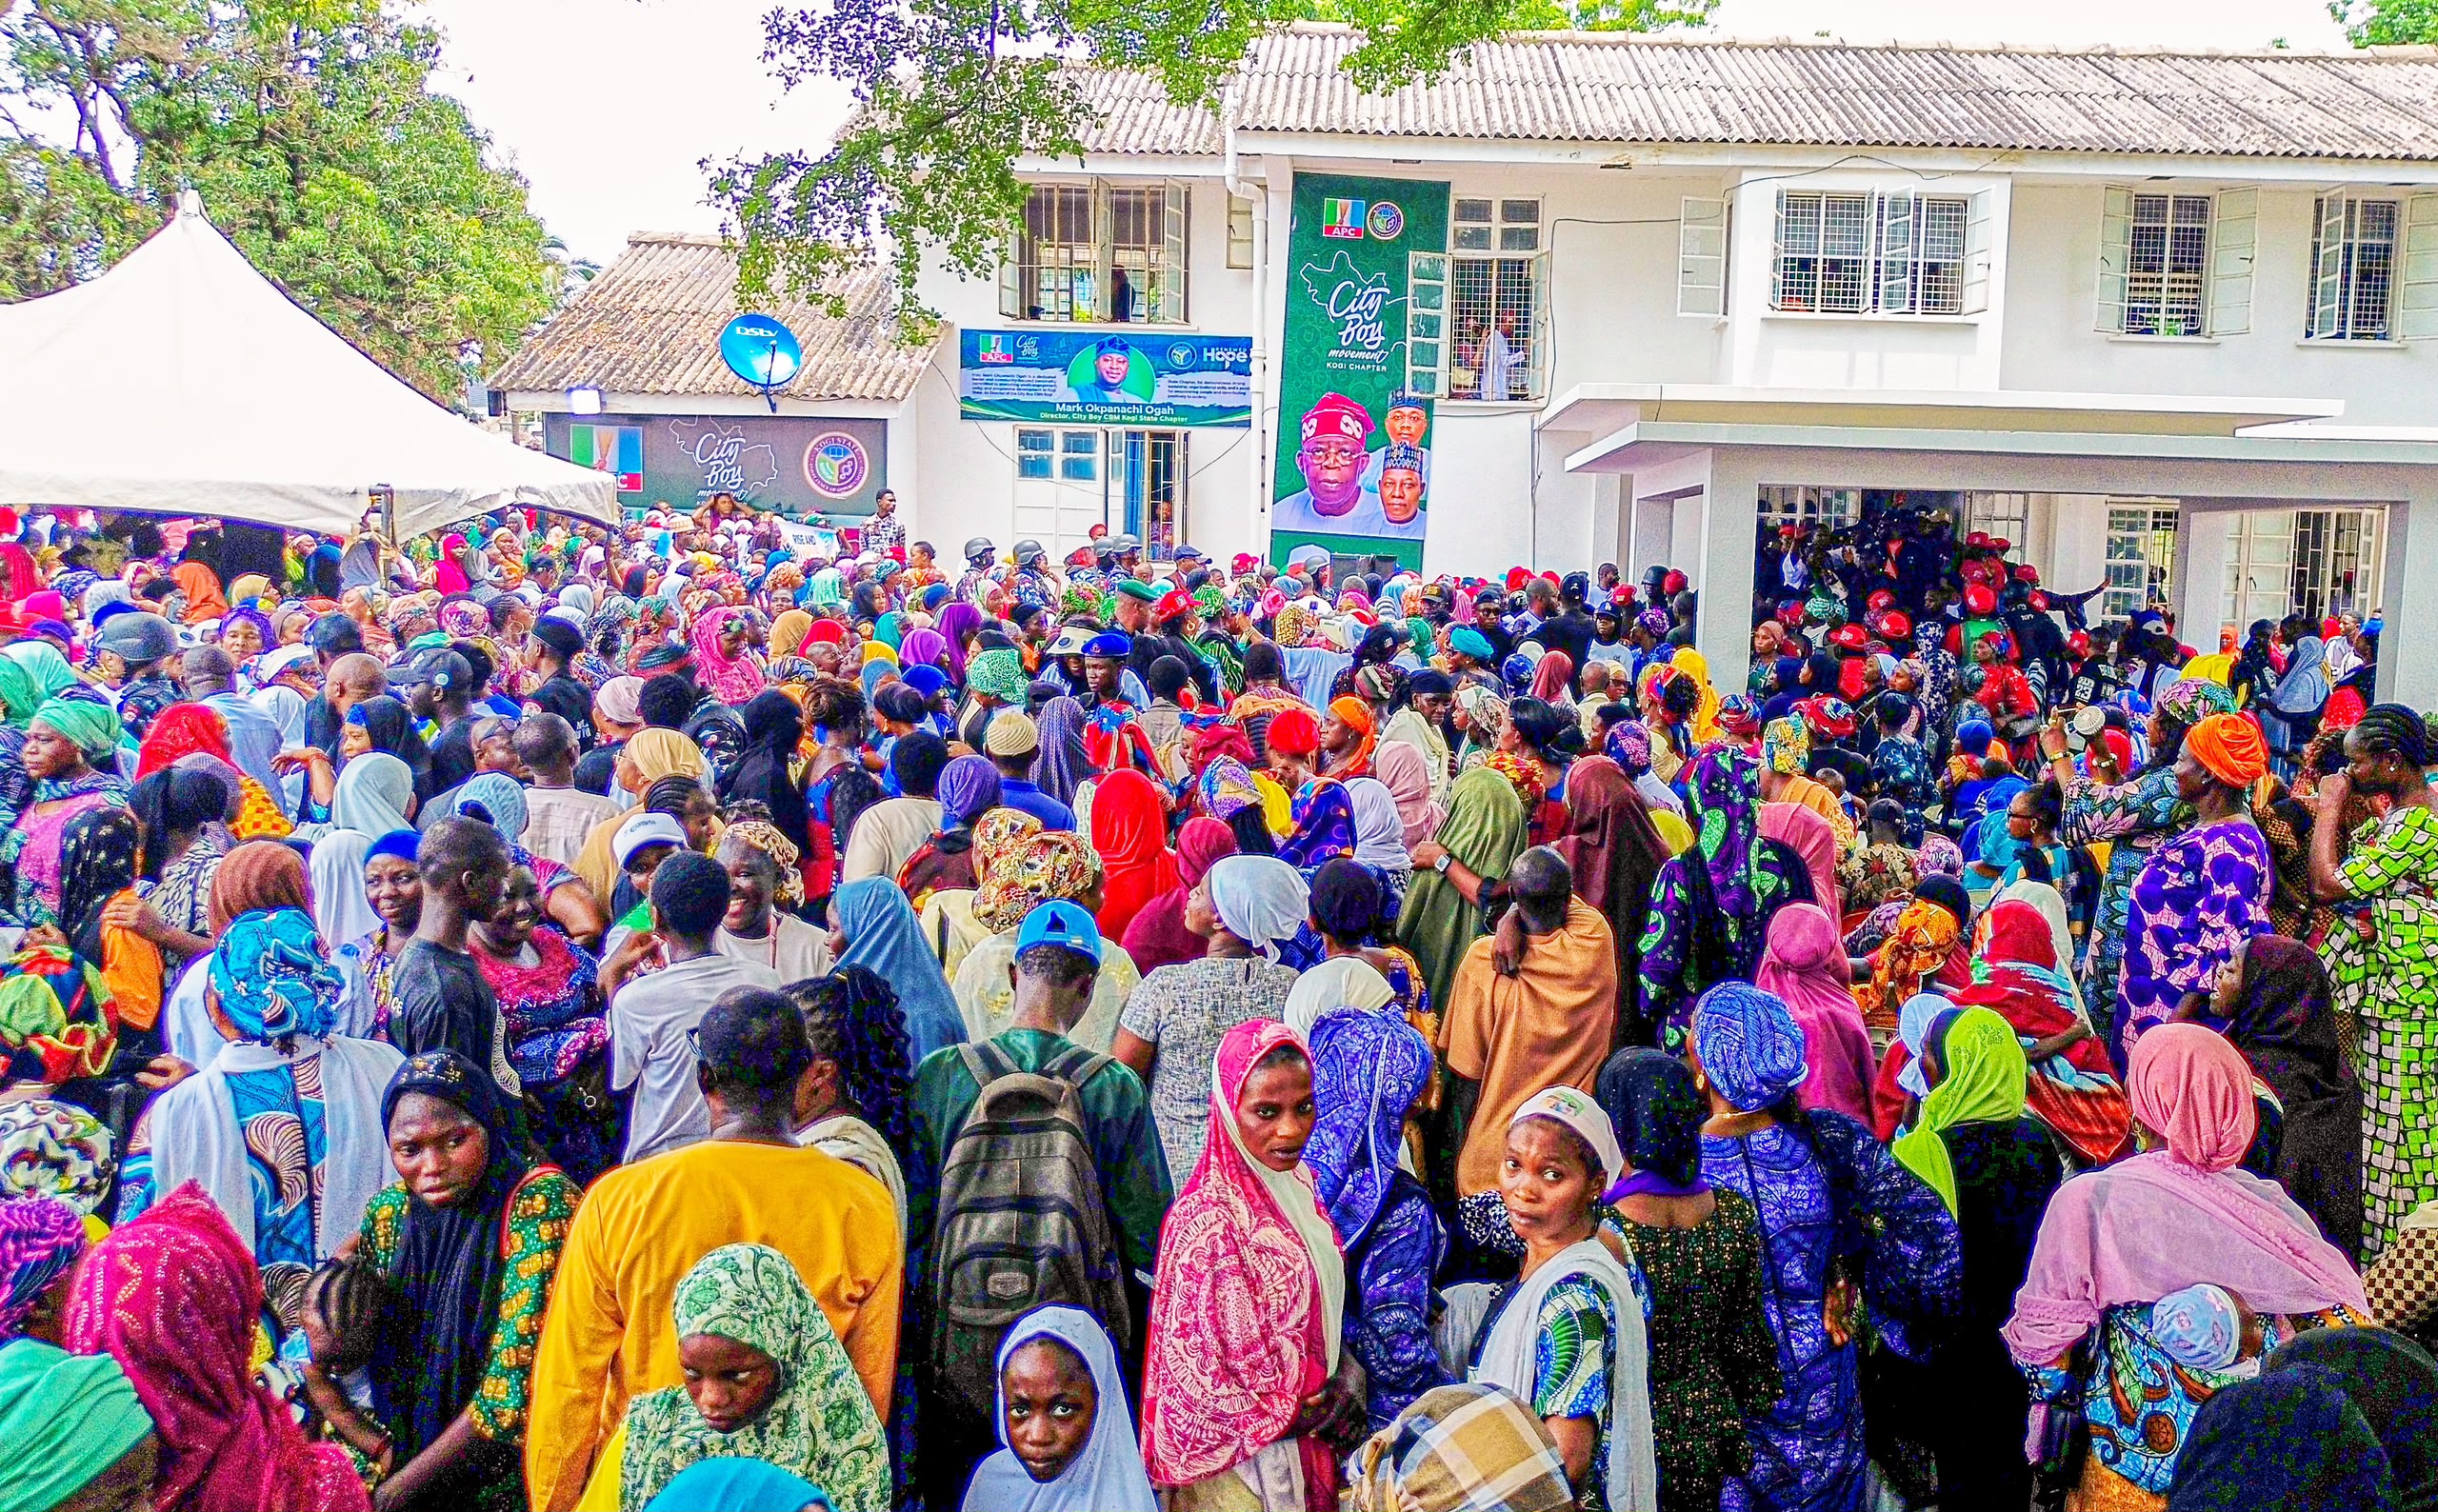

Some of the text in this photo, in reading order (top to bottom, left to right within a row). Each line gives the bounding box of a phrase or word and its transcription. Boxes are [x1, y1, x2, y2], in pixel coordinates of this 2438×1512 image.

[1332, 227, 1356, 236] APC
[1329, 280, 1390, 320] City
[1338, 313, 1385, 350] Boy
[1016, 335, 1040, 348] City
[988, 353, 1007, 362] APC
[1020, 345, 1038, 357] Boy
[1328, 349, 1389, 363] movement
[1203, 348, 1248, 370] Hope
[1349, 363, 1387, 372] CHAPTER
[1056, 403, 1174, 416] Mark Okpanachi Ogah
[696, 433, 746, 465] City
[814, 437, 860, 453] KOGI STATE
[705, 460, 745, 489] Boy
[792, 534, 817, 545] RISE AND
